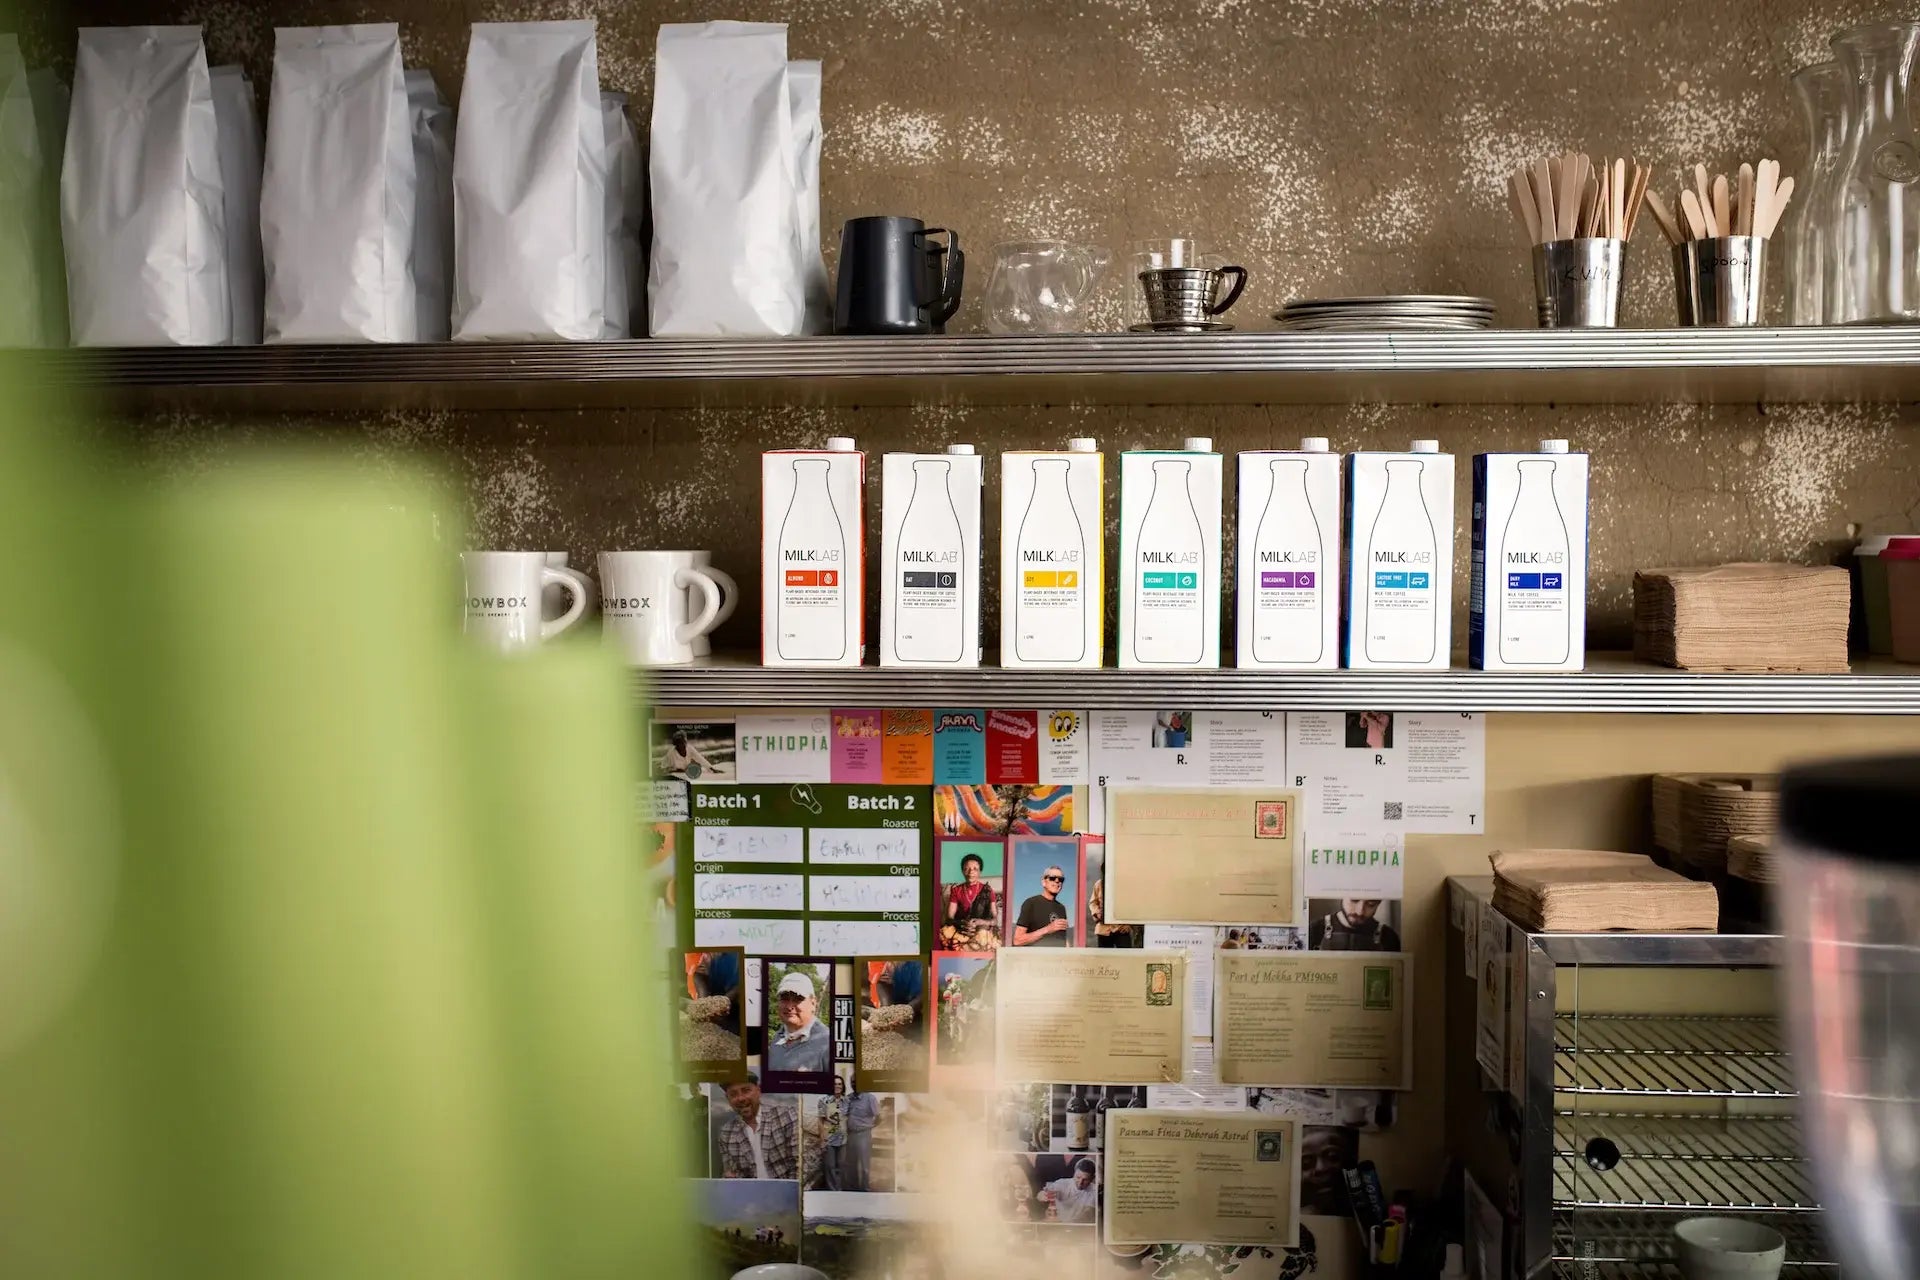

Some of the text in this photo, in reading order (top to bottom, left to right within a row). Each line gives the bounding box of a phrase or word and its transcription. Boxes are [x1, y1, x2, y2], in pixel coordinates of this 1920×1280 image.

[785, 550, 840, 561] MILKLAB
[903, 550, 958, 563] MILKLAB
[1023, 550, 1079, 562] MILKLAB
[1142, 552, 1198, 564] MILKLAB
[1260, 551, 1316, 563] MILKLAB
[1375, 551, 1430, 563] MILKLAB
[1508, 552, 1564, 564] MILKLAB
[742, 736, 828, 751] ETHIOPIA
[1177, 754, 1188, 765] R.
[1375, 754, 1386, 765] R.
[696, 794, 747, 808] Batch
[752, 794, 761, 808] 1
[848, 795, 915, 810] Batch 2
[694, 816, 730, 825] Roaster
[882, 819, 919, 828] Roaster
[1312, 849, 1400, 866] ETHIOPIA
[694, 863, 723, 873] Origin
[890, 865, 919, 876] Origin
[695, 910, 731, 919] Process
[883, 912, 919, 921] Process
[1251, 970, 1260, 984] of
[836, 1042, 854, 1058] PIA
[1119, 1127, 1250, 1141] Panama Finca Deborah Astral
